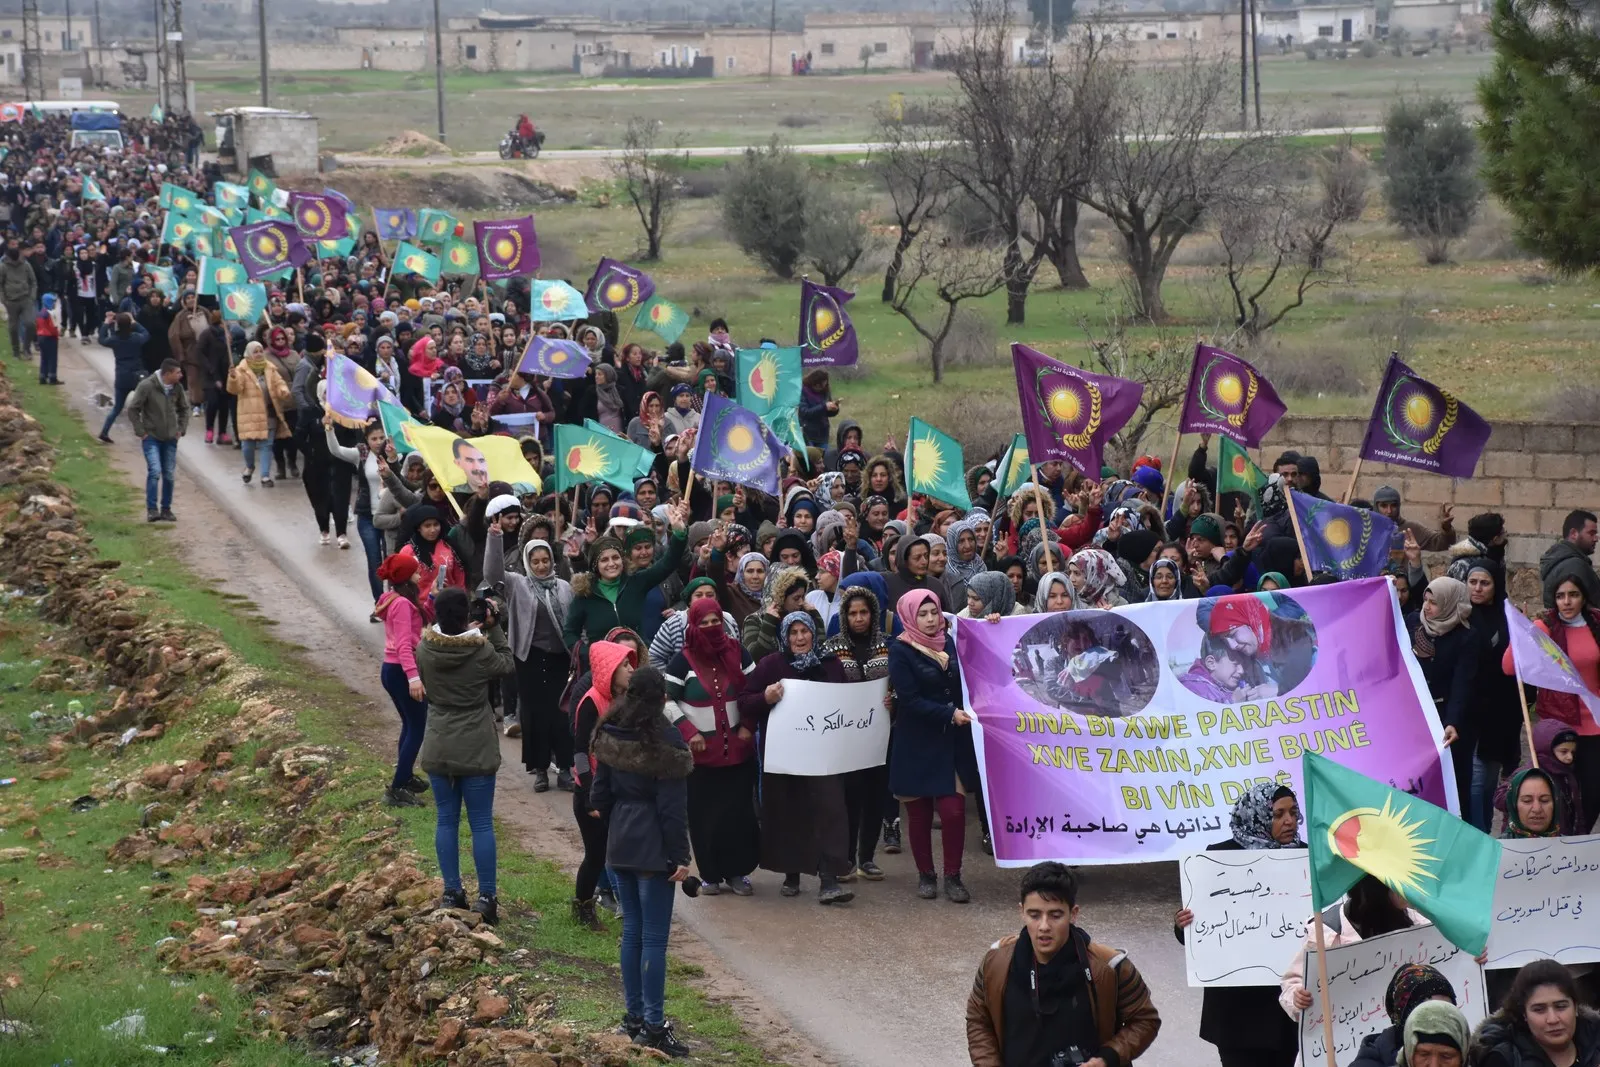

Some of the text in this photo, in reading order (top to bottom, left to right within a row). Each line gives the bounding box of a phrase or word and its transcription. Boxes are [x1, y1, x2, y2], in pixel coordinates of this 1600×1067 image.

[821, 708, 855, 736] عدالتكم
[856, 707, 876, 730] أين
[1015, 688, 1361, 740] JINA BI XWE PARASTIN
[1026, 743, 1094, 772] XWE
[1121, 785, 1151, 811] BI
[1156, 781, 1215, 811] VÎN
[1005, 813, 1223, 845] لذاتها هي صاحبة الإرادة
[1549, 895, 1572, 918] قتل
[1571, 894, 1583, 920] في
[1224, 911, 1269, 939] الشمال
[1270, 912, 1295, 939] على
[1349, 951, 1393, 985] الشعب
